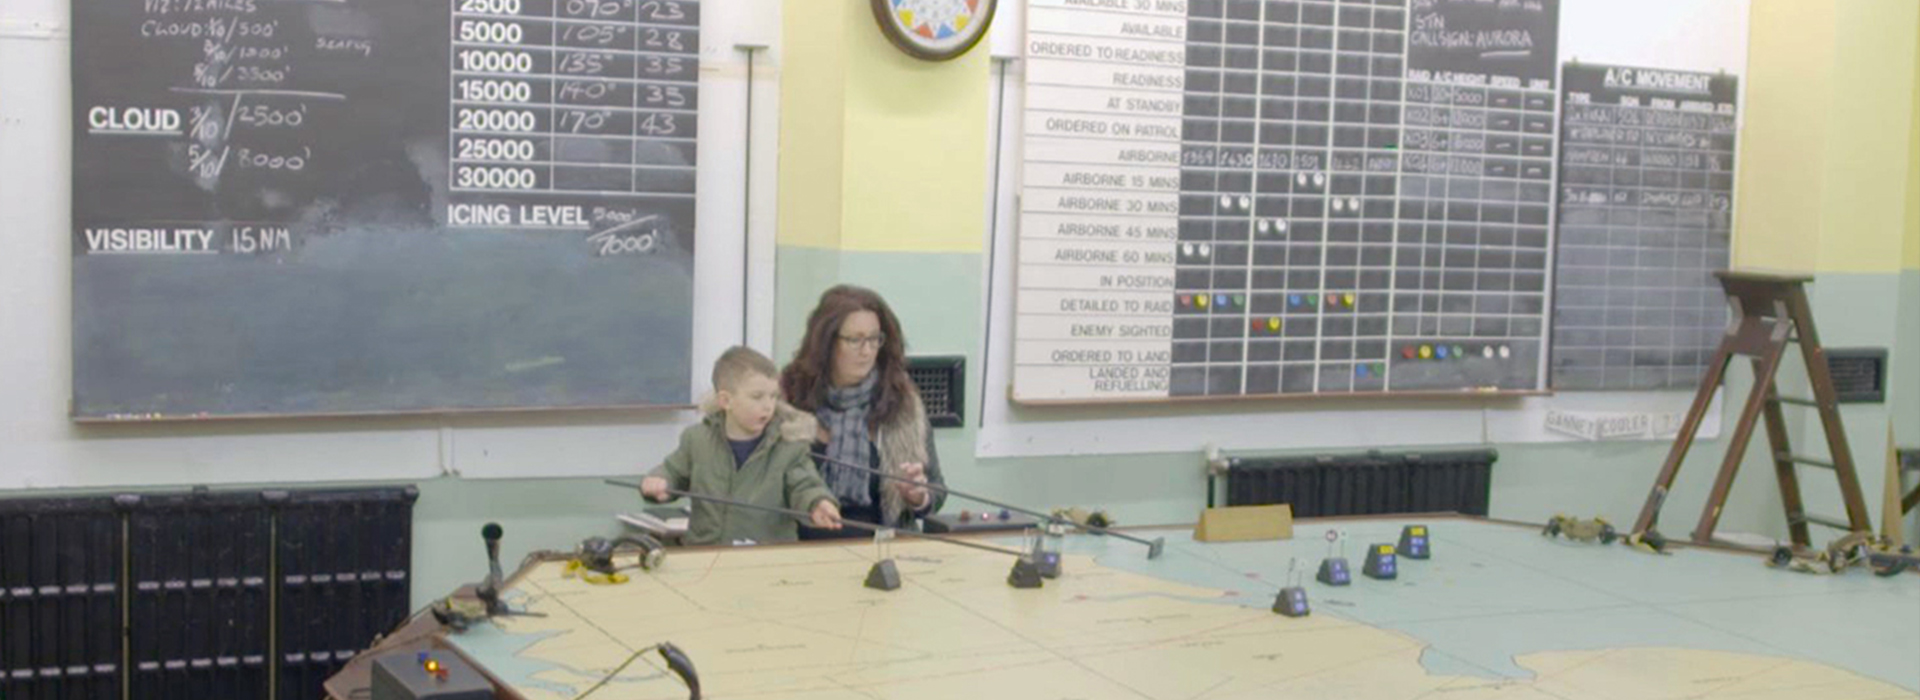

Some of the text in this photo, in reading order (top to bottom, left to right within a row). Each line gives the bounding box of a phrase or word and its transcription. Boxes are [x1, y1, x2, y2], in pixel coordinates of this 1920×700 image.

[460, 0, 520, 14] 2500
[460, 21, 522, 43] 5000
[645, 28, 683, 50] 28
[1120, 22, 1184, 38] AVAILABLE
[459, 50, 532, 73] 10000
[1030, 41, 1185, 64] ORDERED TO READINESS
[1113, 72, 1184, 88] READINESS
[1604, 67, 1711, 91] A/C MOVEMENT
[459, 80, 530, 102] 15000
[1107, 96, 1182, 113] AT STANDBY
[88, 106, 181, 131] CLOUD
[458, 109, 535, 132] 20000
[641, 112, 676, 135] 43
[1046, 118, 1179, 139] ORDERED ON PATROL
[458, 138, 535, 161] 25000
[1118, 149, 1180, 163] AIRBORNE
[458, 167, 536, 189] 30000
[1062, 172, 1180, 190] AIRBORNE 15 MINS
[1057, 196, 1178, 214] AIRBORNE 30 MINS
[448, 203, 590, 226] ICING LEVEL
[86, 229, 213, 250] VISIBILITY
[1057, 222, 1177, 240] AIRBORNE 45 MINS
[1055, 248, 1174, 265] AIRBORNE 60 MINS
[1100, 275, 1173, 288] IN POSITION
[1060, 298, 1172, 313] DETAILED TO RAID
[1070, 324, 1171, 338] ENEMY SIGHTED
[1051, 349, 1170, 363] ORDERED TO LAND
[1090, 366, 1169, 379] LANDED AND
[1094, 379, 1169, 391] REFUELLING
